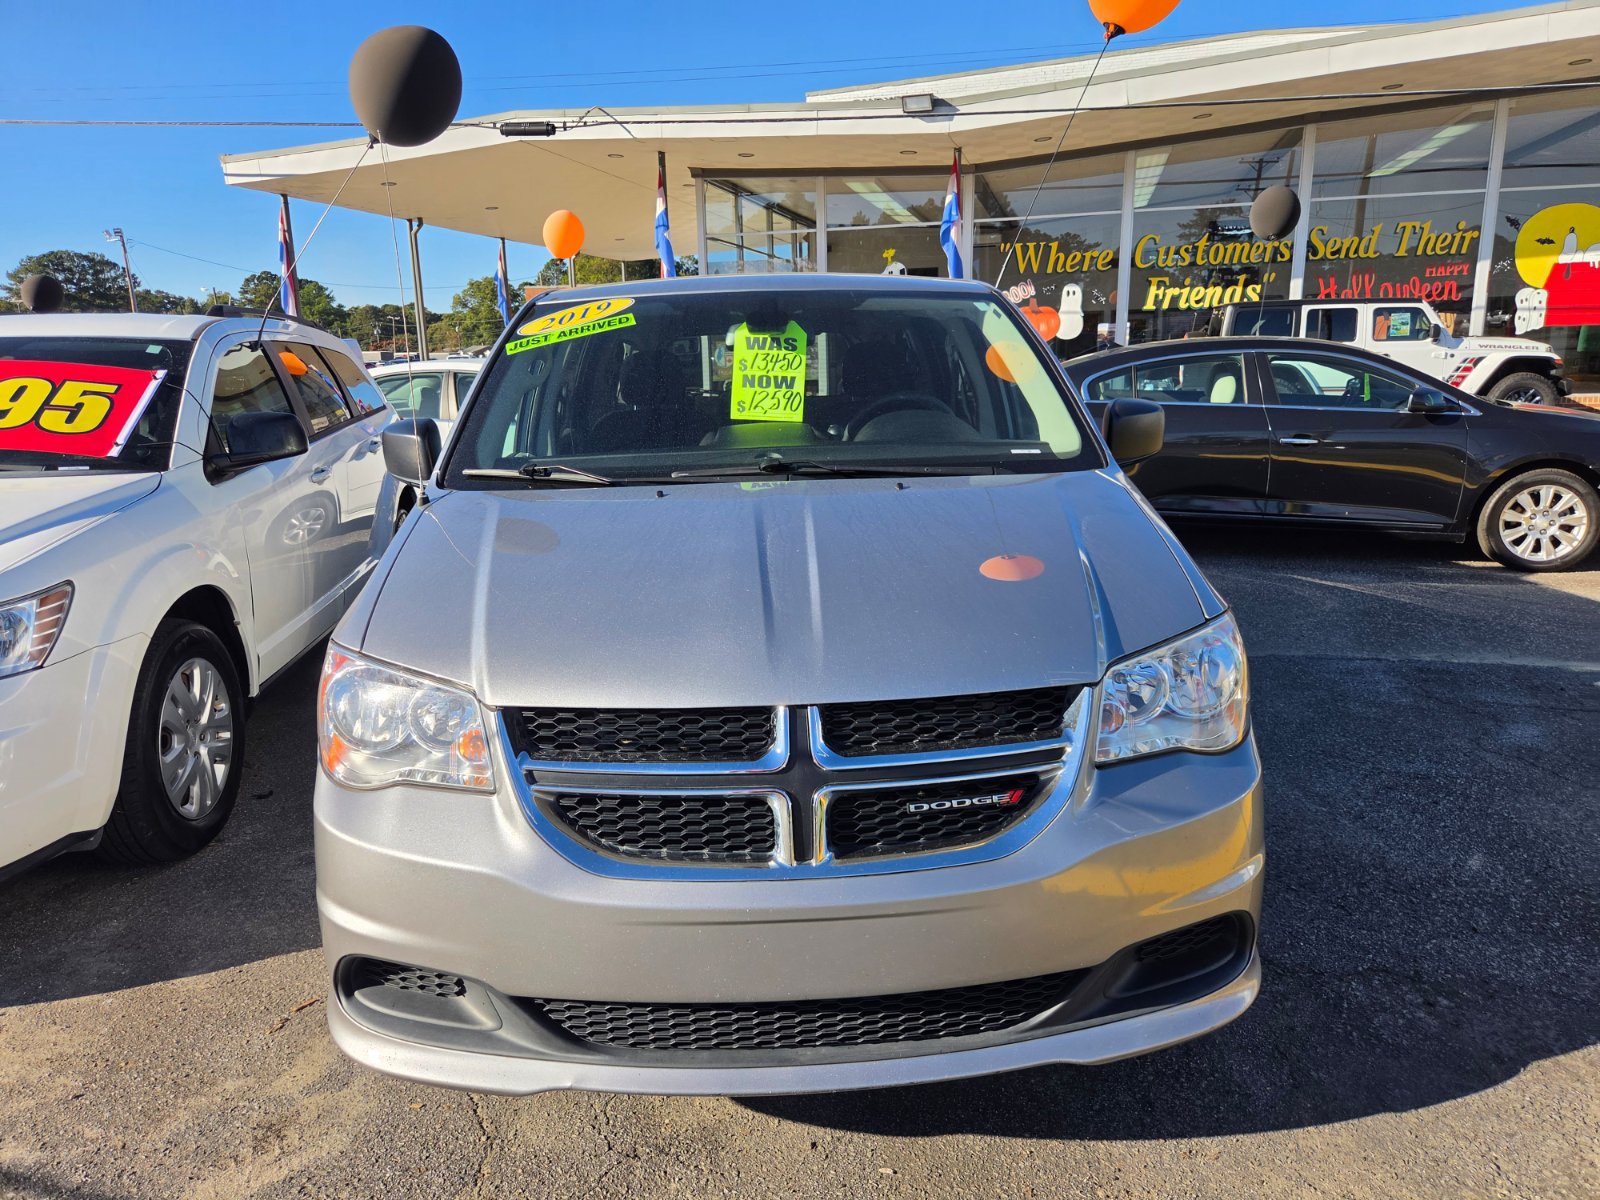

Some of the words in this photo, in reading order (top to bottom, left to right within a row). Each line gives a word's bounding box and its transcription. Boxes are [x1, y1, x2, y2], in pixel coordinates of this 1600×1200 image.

[1000, 240, 1114, 274] "Where
[1134, 233, 1293, 269] Customers
[1308, 223, 1383, 260] Send
[1394, 219, 1480, 257] Their
[1425, 263, 1470, 277] HAPPY
[540, 301, 612, 331] 2019
[509, 334, 553, 352] JUST
[557, 316, 630, 340] ARRIVED
[745, 336, 798, 352] WAS
[1478, 342, 1539, 351] WRANGLER
[742, 374, 796, 390] NOW
[908, 793, 1011, 813] DODGE
